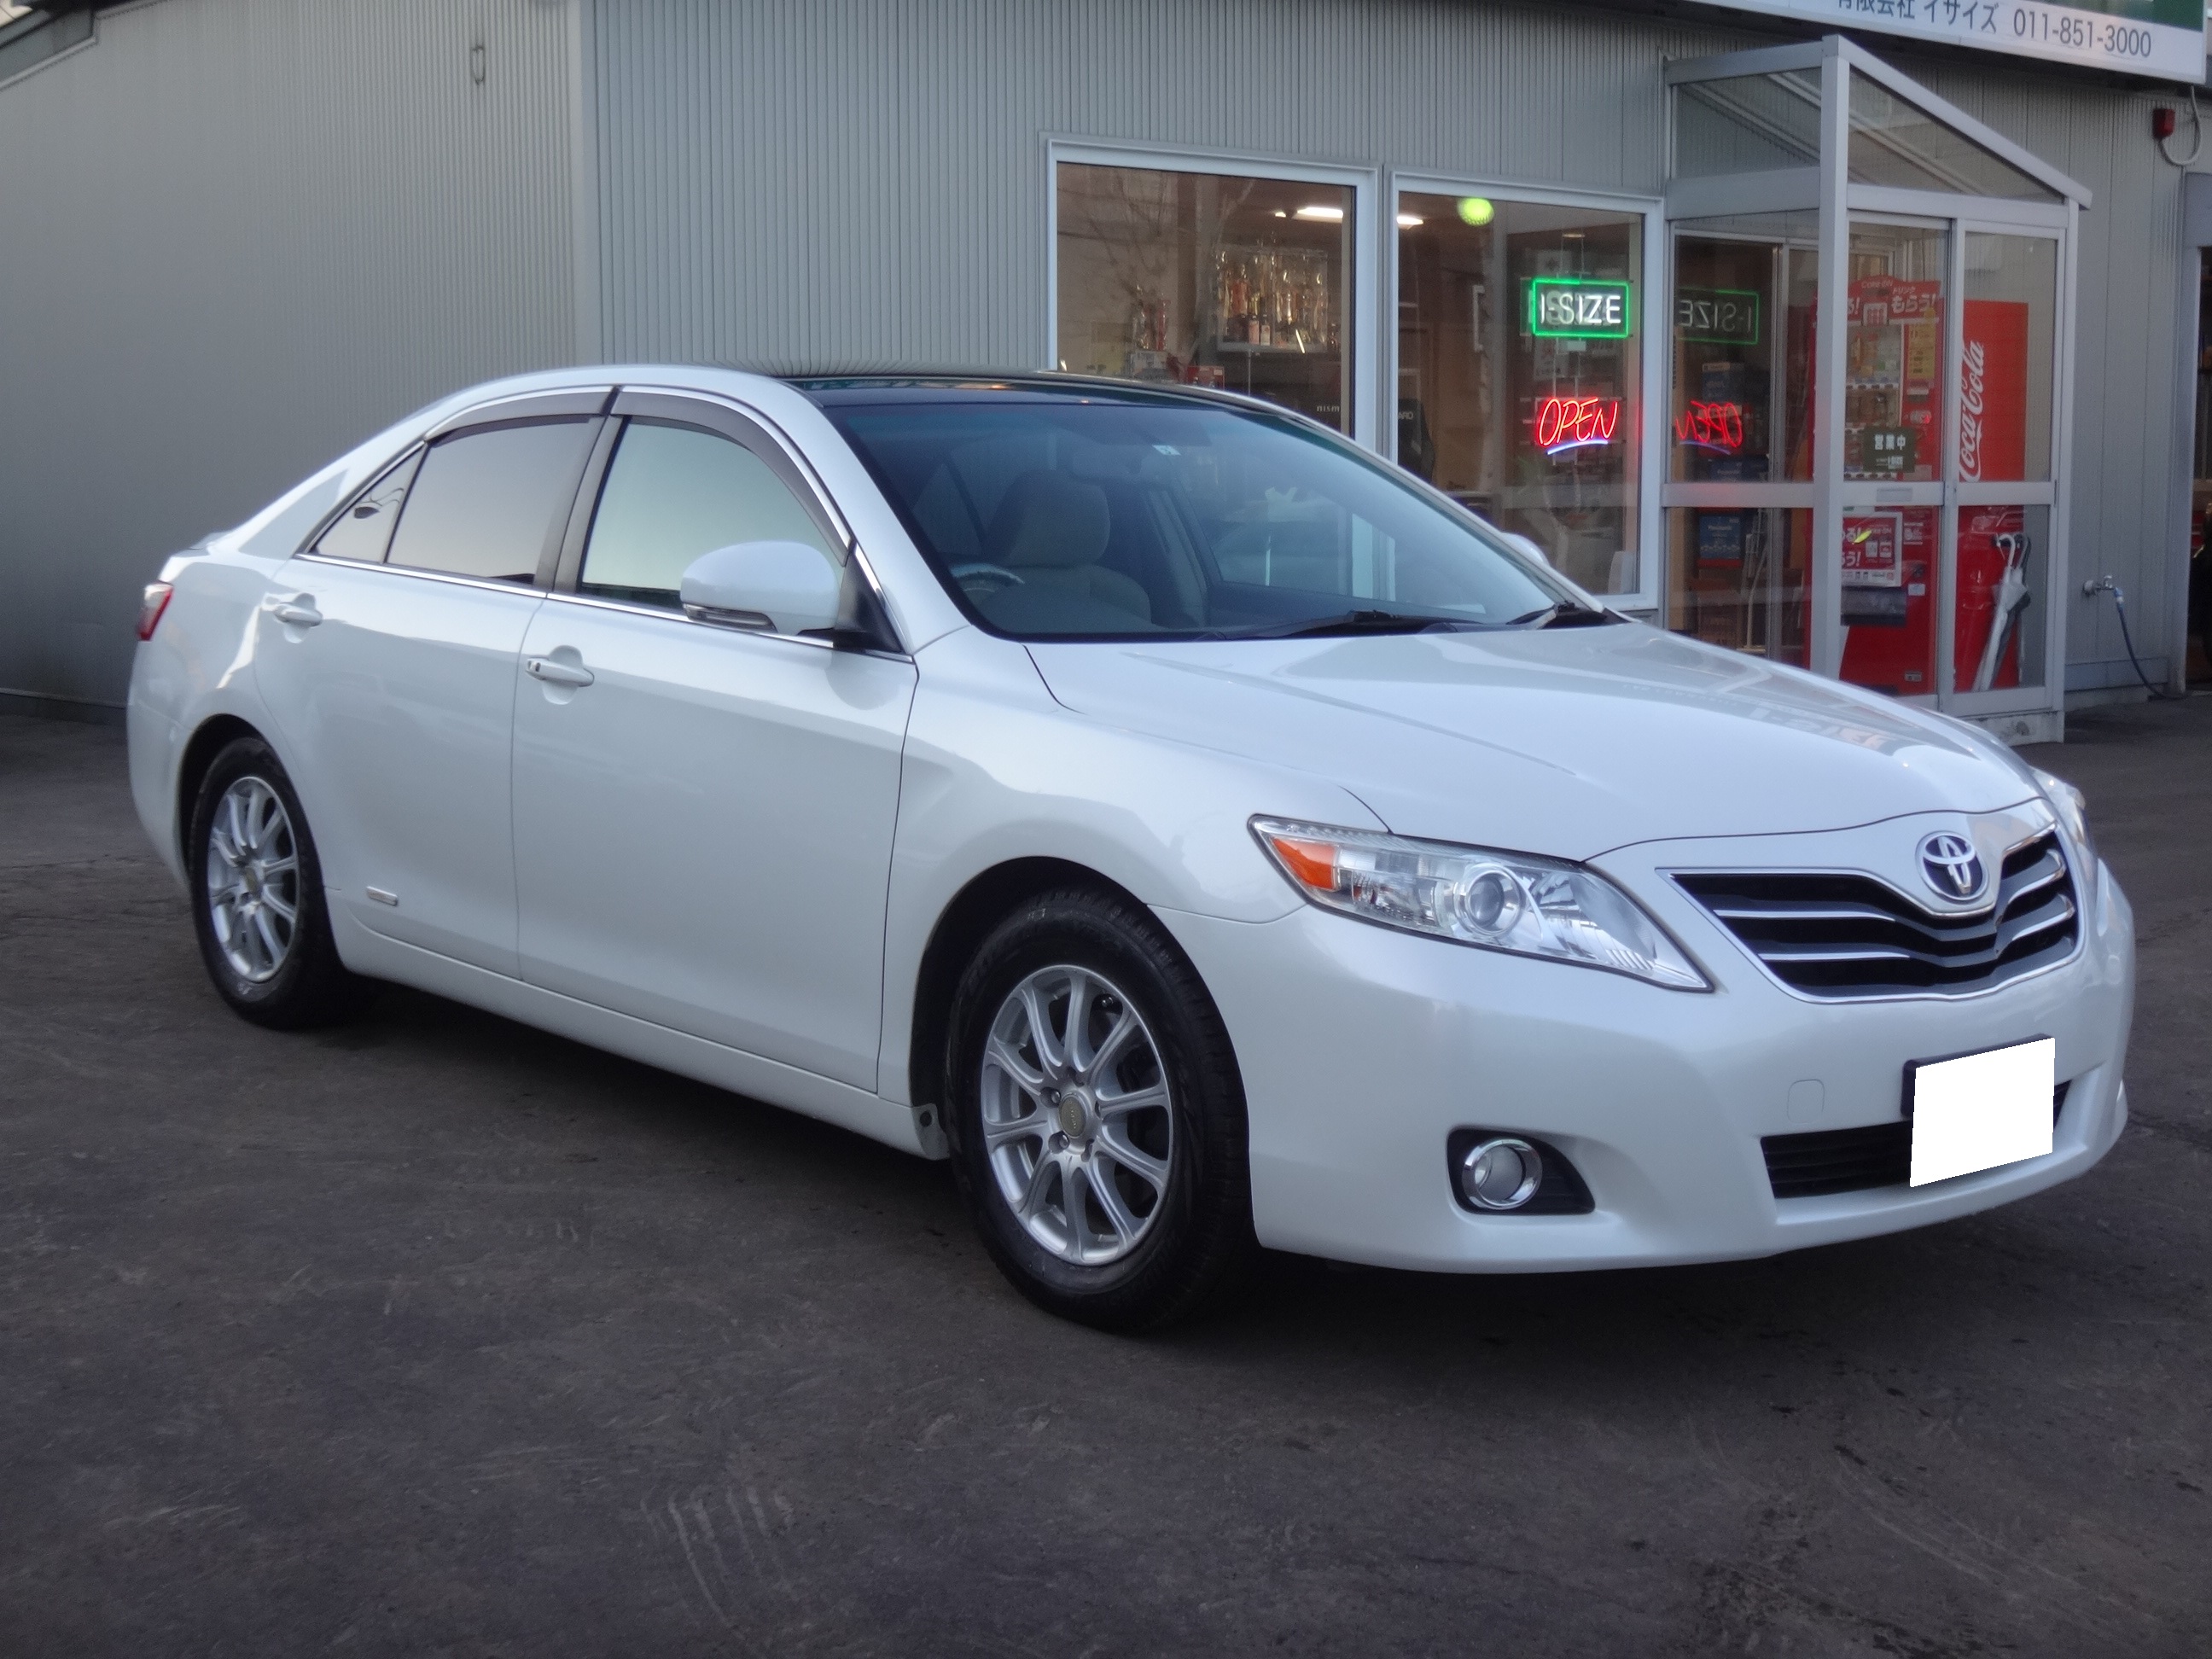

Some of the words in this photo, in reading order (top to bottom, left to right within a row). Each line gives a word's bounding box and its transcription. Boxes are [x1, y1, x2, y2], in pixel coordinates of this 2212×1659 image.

[1924, 0, 2000, 33] イサイズ
[2013, 9, 2151, 57] 011-851-3000
[1540, 293, 1621, 323] I-SIZE
[1539, 398, 1618, 446] OPEN
[1960, 341, 1985, 484] Coca-Cola
